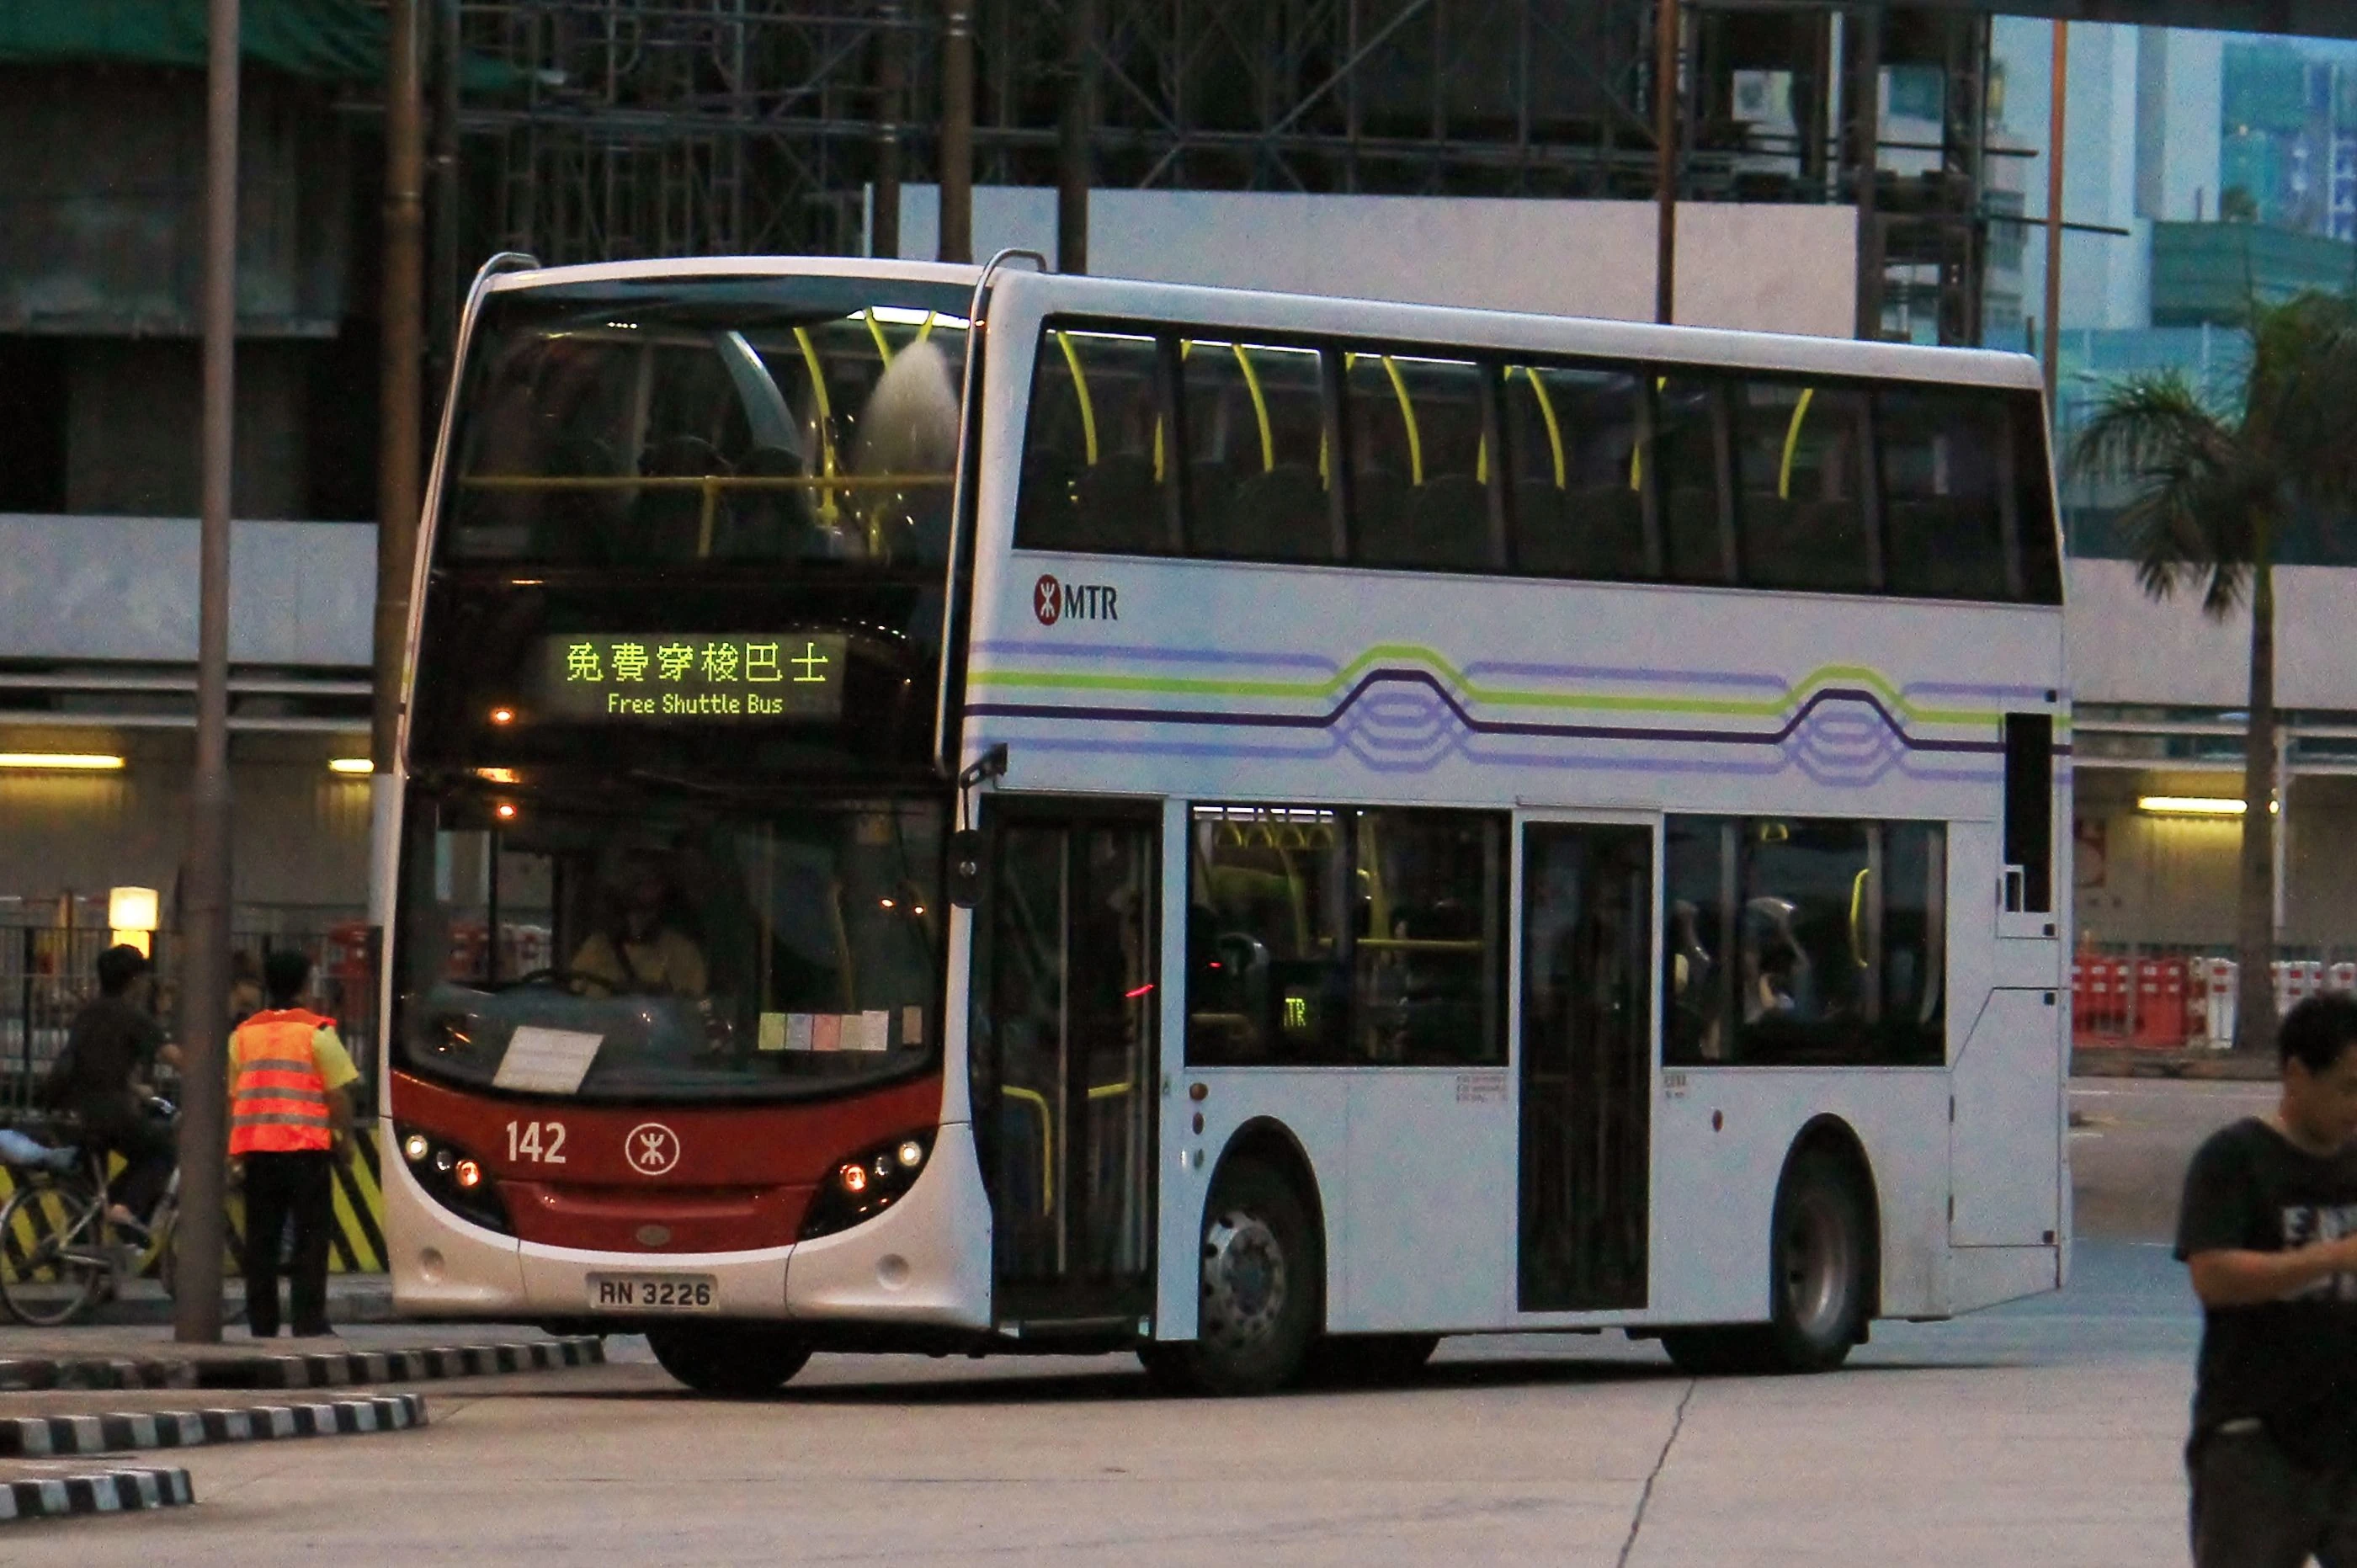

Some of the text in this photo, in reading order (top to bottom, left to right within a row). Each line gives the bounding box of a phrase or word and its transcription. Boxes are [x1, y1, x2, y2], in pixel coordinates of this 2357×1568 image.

[1065, 584, 1118, 620] MTR
[567, 641, 829, 682] 免費穿梭巴士
[608, 694, 783, 714] Free Shuttle Bus
[507, 1120, 567, 1164] 142
[599, 1282, 711, 1306] RN 3226
